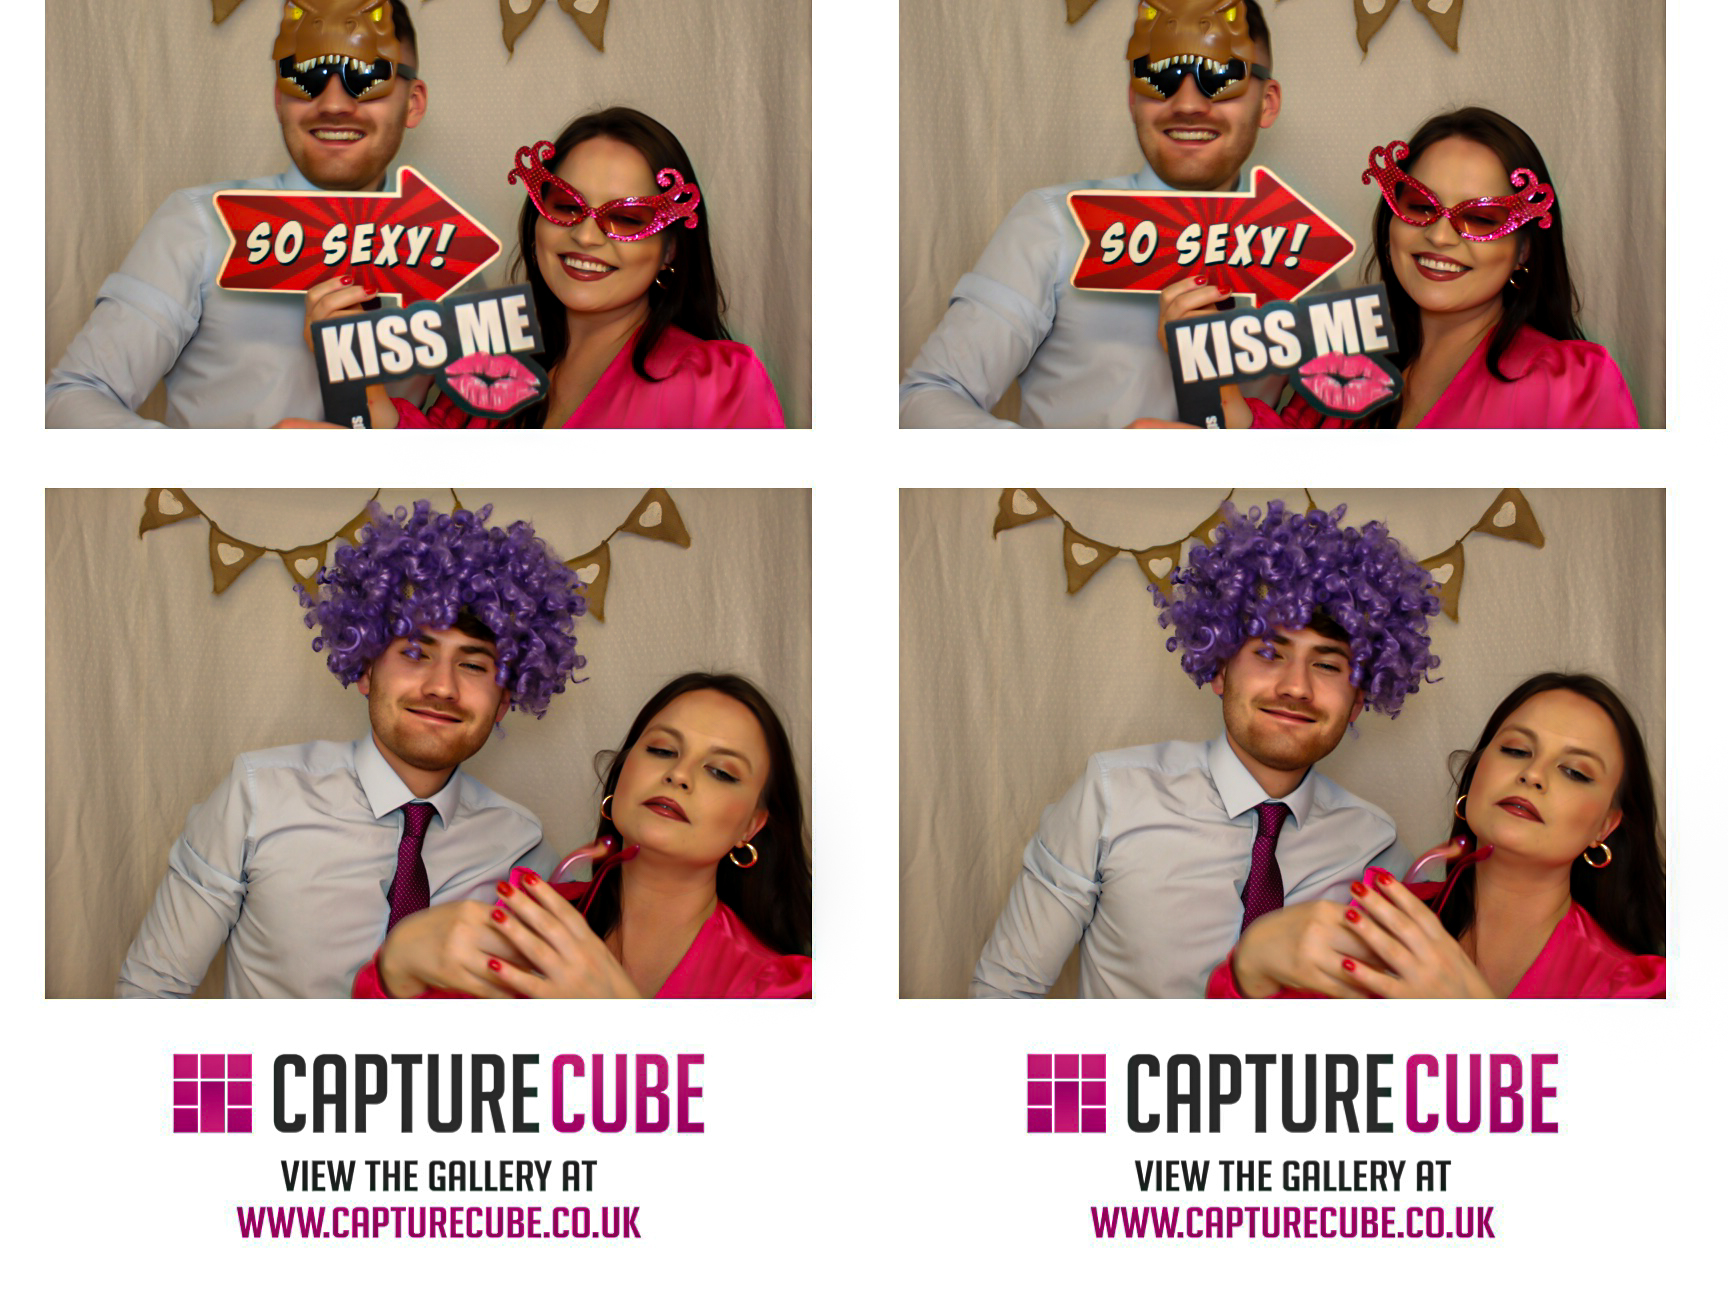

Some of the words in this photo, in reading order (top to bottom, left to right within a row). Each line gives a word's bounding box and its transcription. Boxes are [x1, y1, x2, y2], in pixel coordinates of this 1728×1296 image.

[246, 220, 304, 264] SO
[322, 222, 456, 268] SEXY!
[1100, 220, 1158, 264] SO
[1176, 222, 1310, 268] SEXY!
[322, 310, 448, 383] KISS
[455, 294, 535, 356] ME
[1176, 310, 1302, 383] KISS
[1309, 294, 1389, 356] ME
